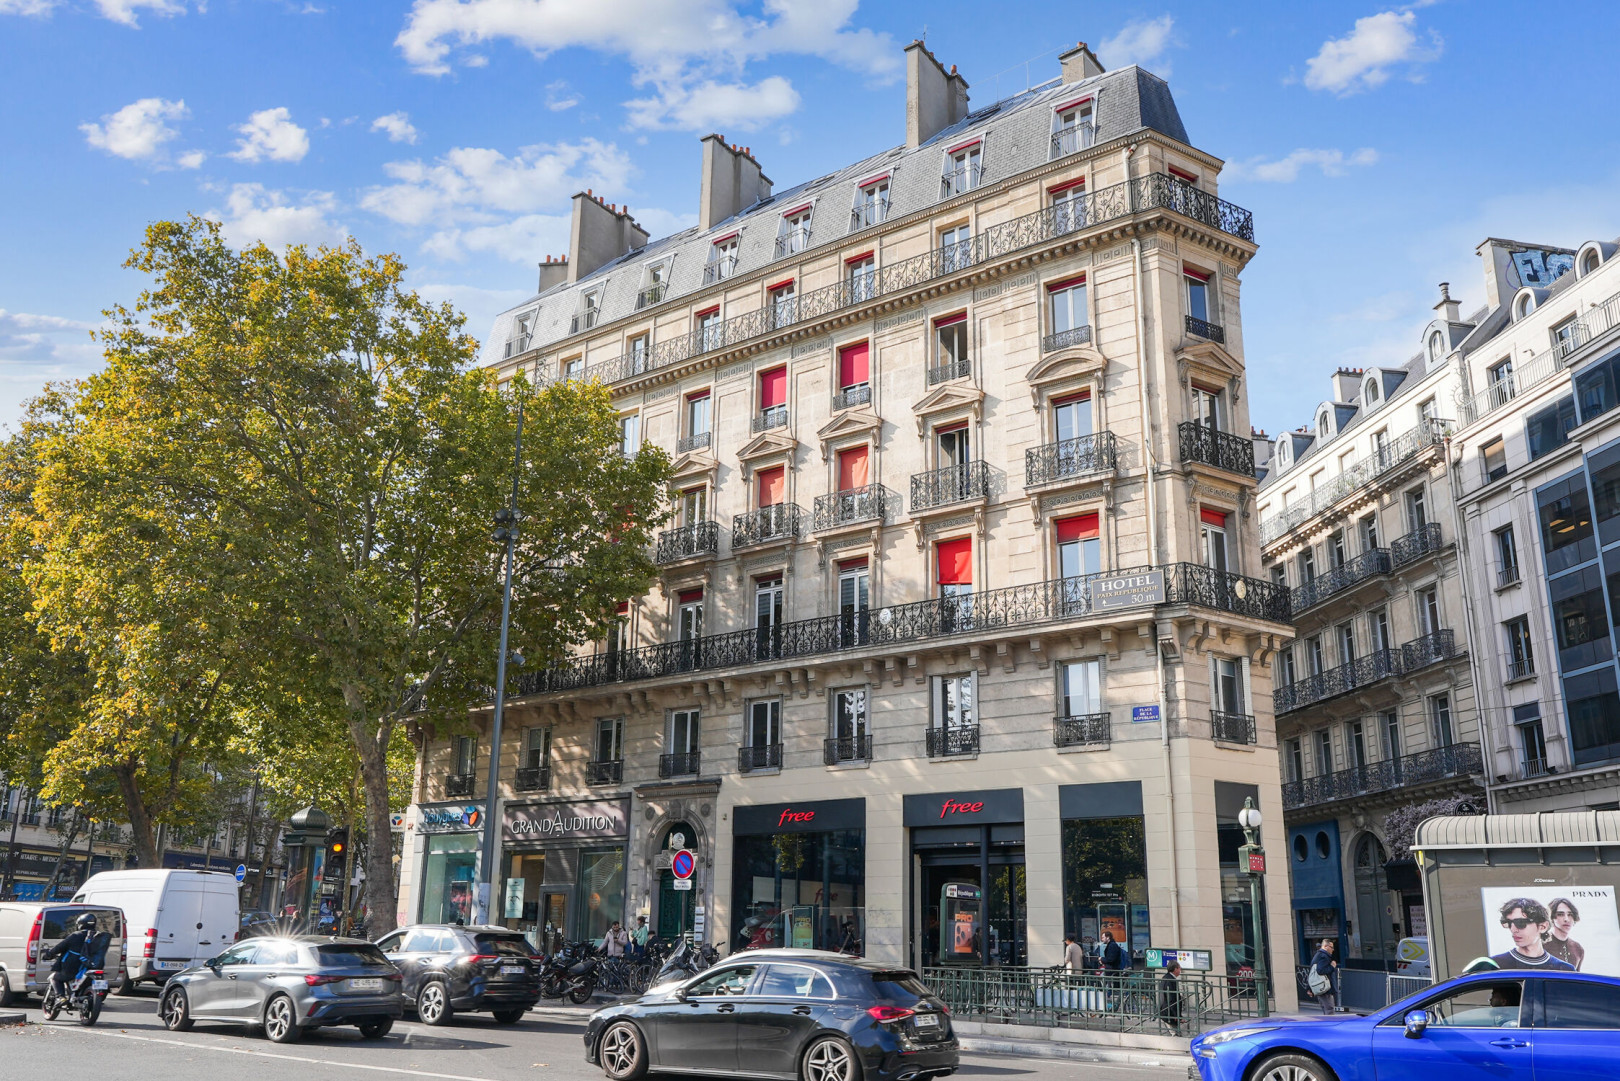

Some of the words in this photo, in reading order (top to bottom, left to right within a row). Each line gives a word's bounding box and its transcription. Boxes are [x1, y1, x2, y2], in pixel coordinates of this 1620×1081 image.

[1101, 575, 1155, 592] HOTEL
[1131, 593, 1144, 604] 50
[1146, 594, 1155, 602] m
[778, 808, 816, 827] free
[940, 798, 985, 820] free
